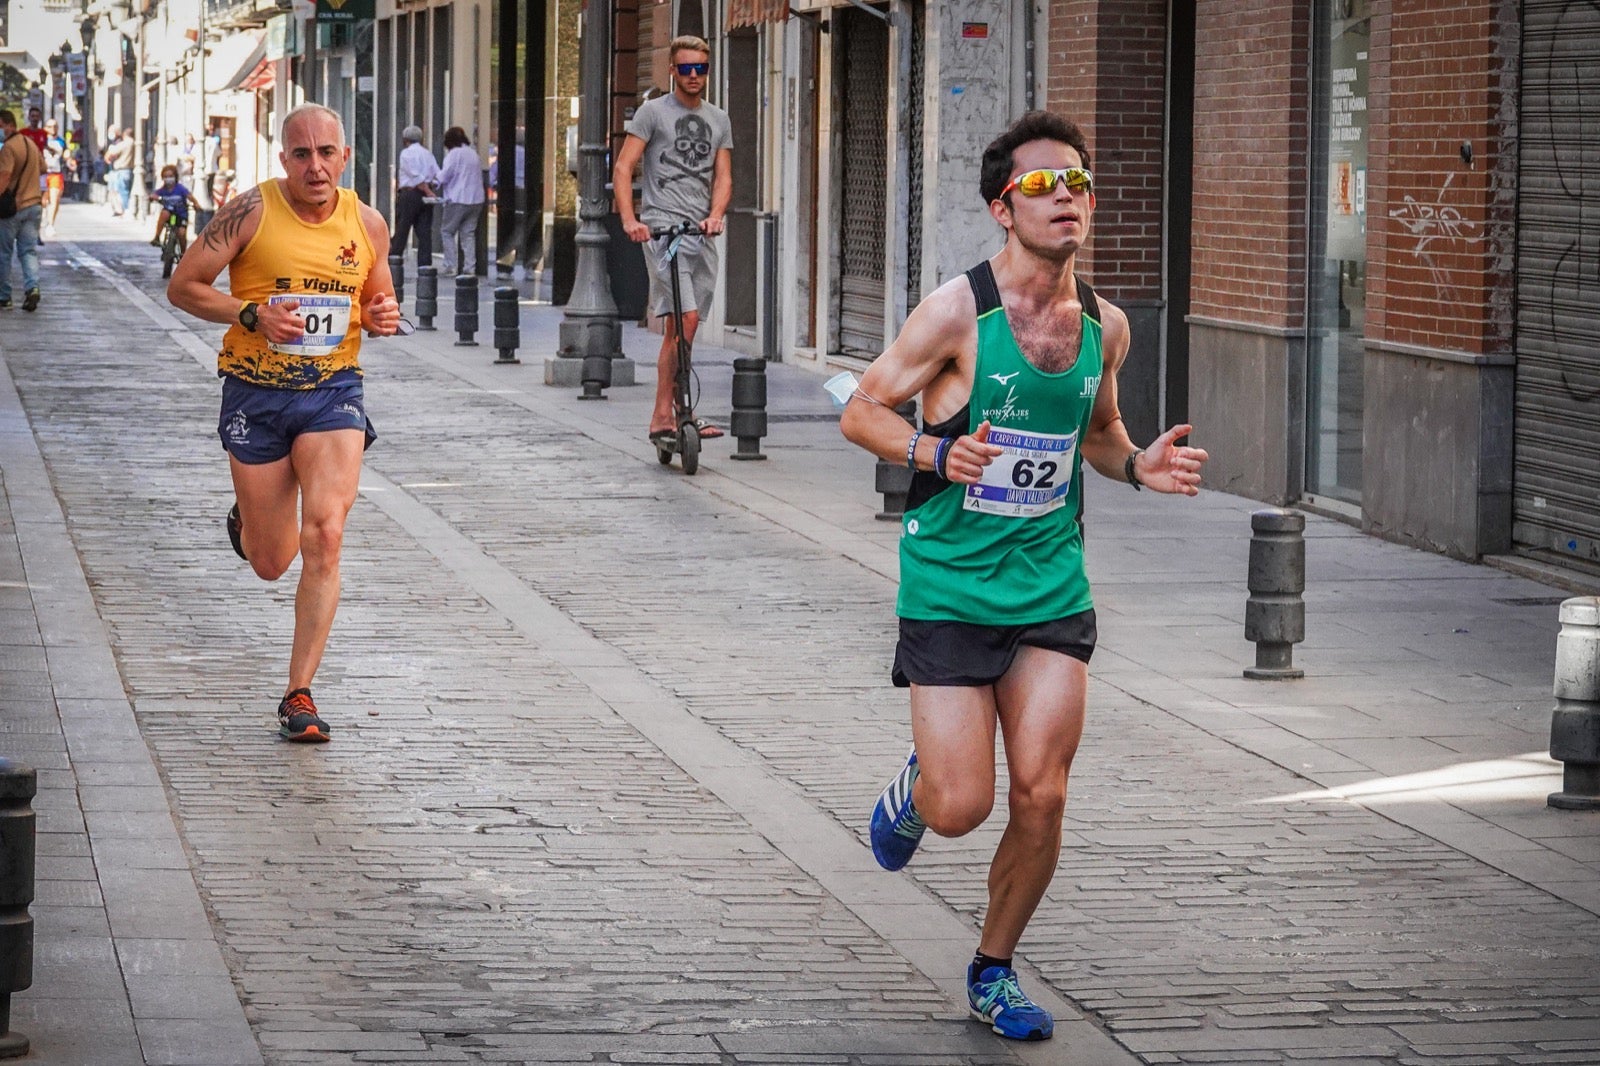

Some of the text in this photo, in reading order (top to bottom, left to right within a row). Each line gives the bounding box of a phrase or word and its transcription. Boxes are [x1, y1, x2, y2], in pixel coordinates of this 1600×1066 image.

[295, 313, 332, 334] 01
[994, 432, 1020, 447] CARRERA
[1023, 436, 1040, 449] AZUL
[1041, 439, 1054, 450] POR
[1055, 440, 1062, 450] EL
[1011, 458, 1058, 489] 62
